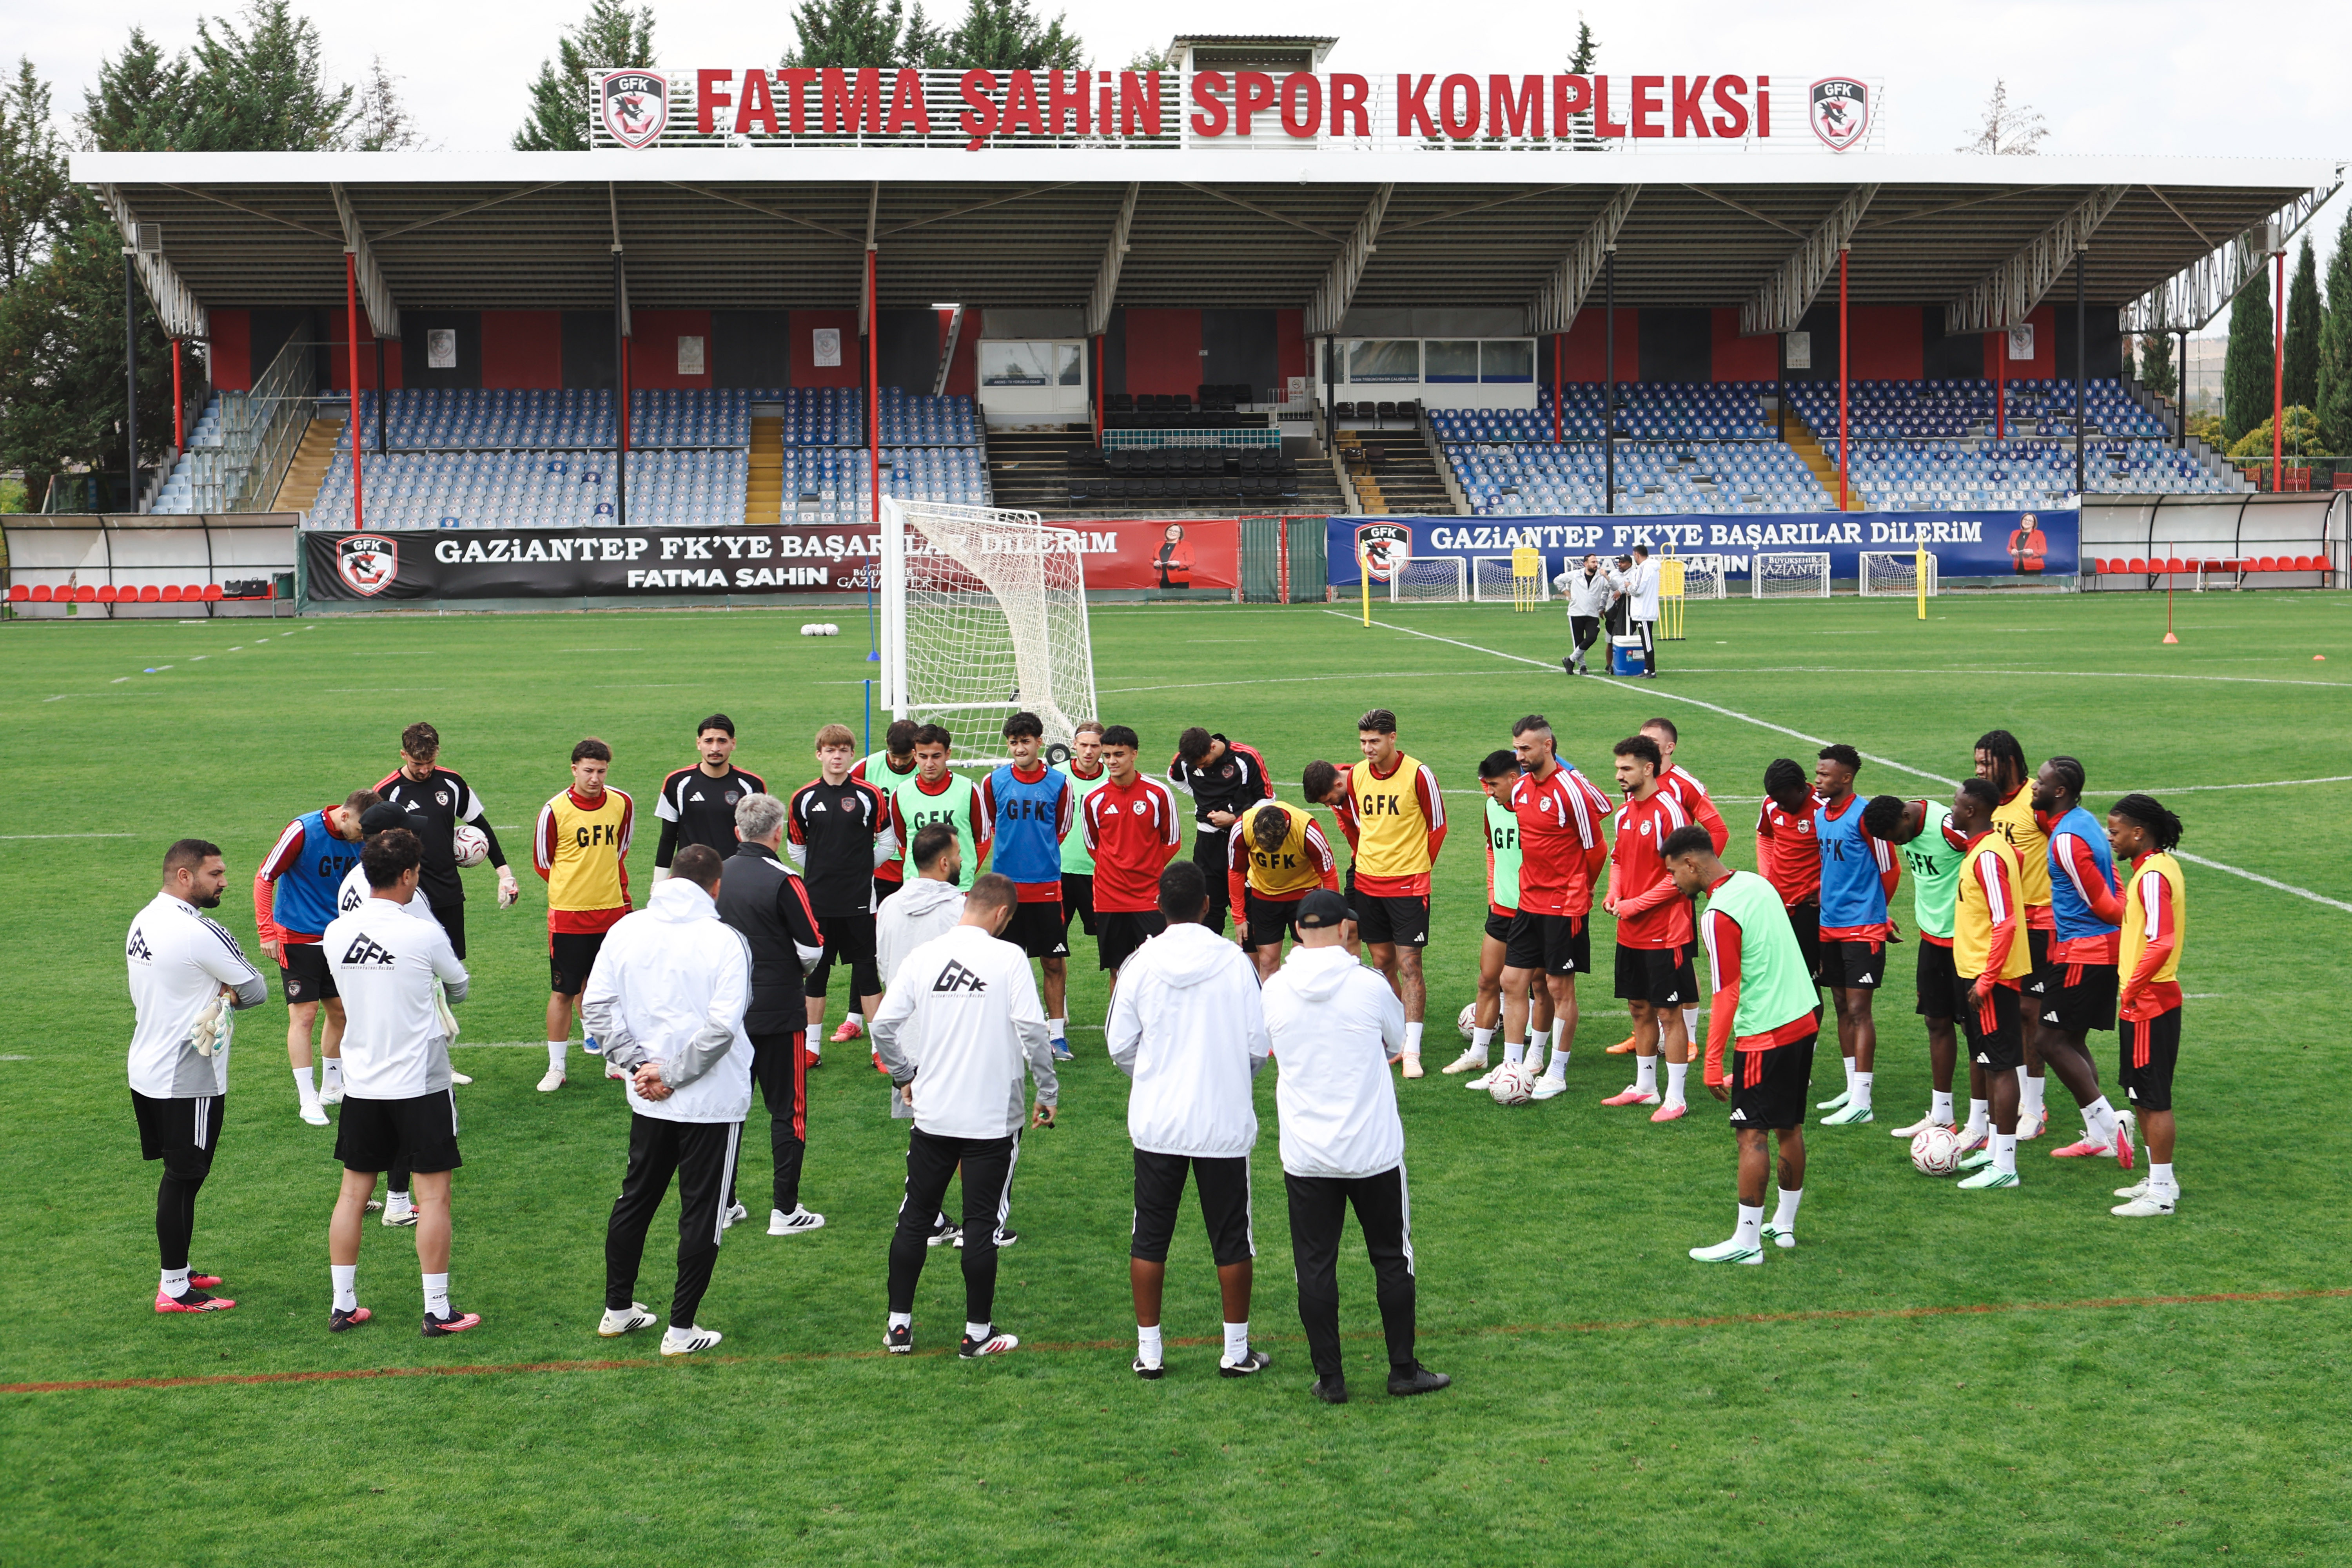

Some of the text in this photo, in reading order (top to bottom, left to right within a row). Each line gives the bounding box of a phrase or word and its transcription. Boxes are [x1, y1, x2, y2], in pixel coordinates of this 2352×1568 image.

[619, 78, 649, 91] GFK
[1824, 83, 1853, 97] GFK
[697, 68, 931, 133] FATMA
[1191, 71, 1370, 138] SPOR
[1371, 527, 1397, 537] GFK
[1613, 524, 1704, 547] FK'YE
[1710, 523, 1862, 550] BAŞARILAR
[353, 540, 382, 550] GFK
[660, 536, 772, 559] FK'YE
[781, 535, 970, 562] BAŞARLAR
[628, 569, 728, 588] FATMA
[1007, 799, 1047, 821] GFK
[1363, 795, 1400, 815] GFK
[914, 810, 955, 831] GFK
[577, 824, 615, 848] GFK
[1494, 828, 1521, 849] GF
[1818, 838, 1845, 861] GFK
[318, 855, 357, 877] GFK
[1255, 852, 1296, 869] GFK
[1906, 850, 1940, 875] GFK
[341, 884, 364, 911] GF
